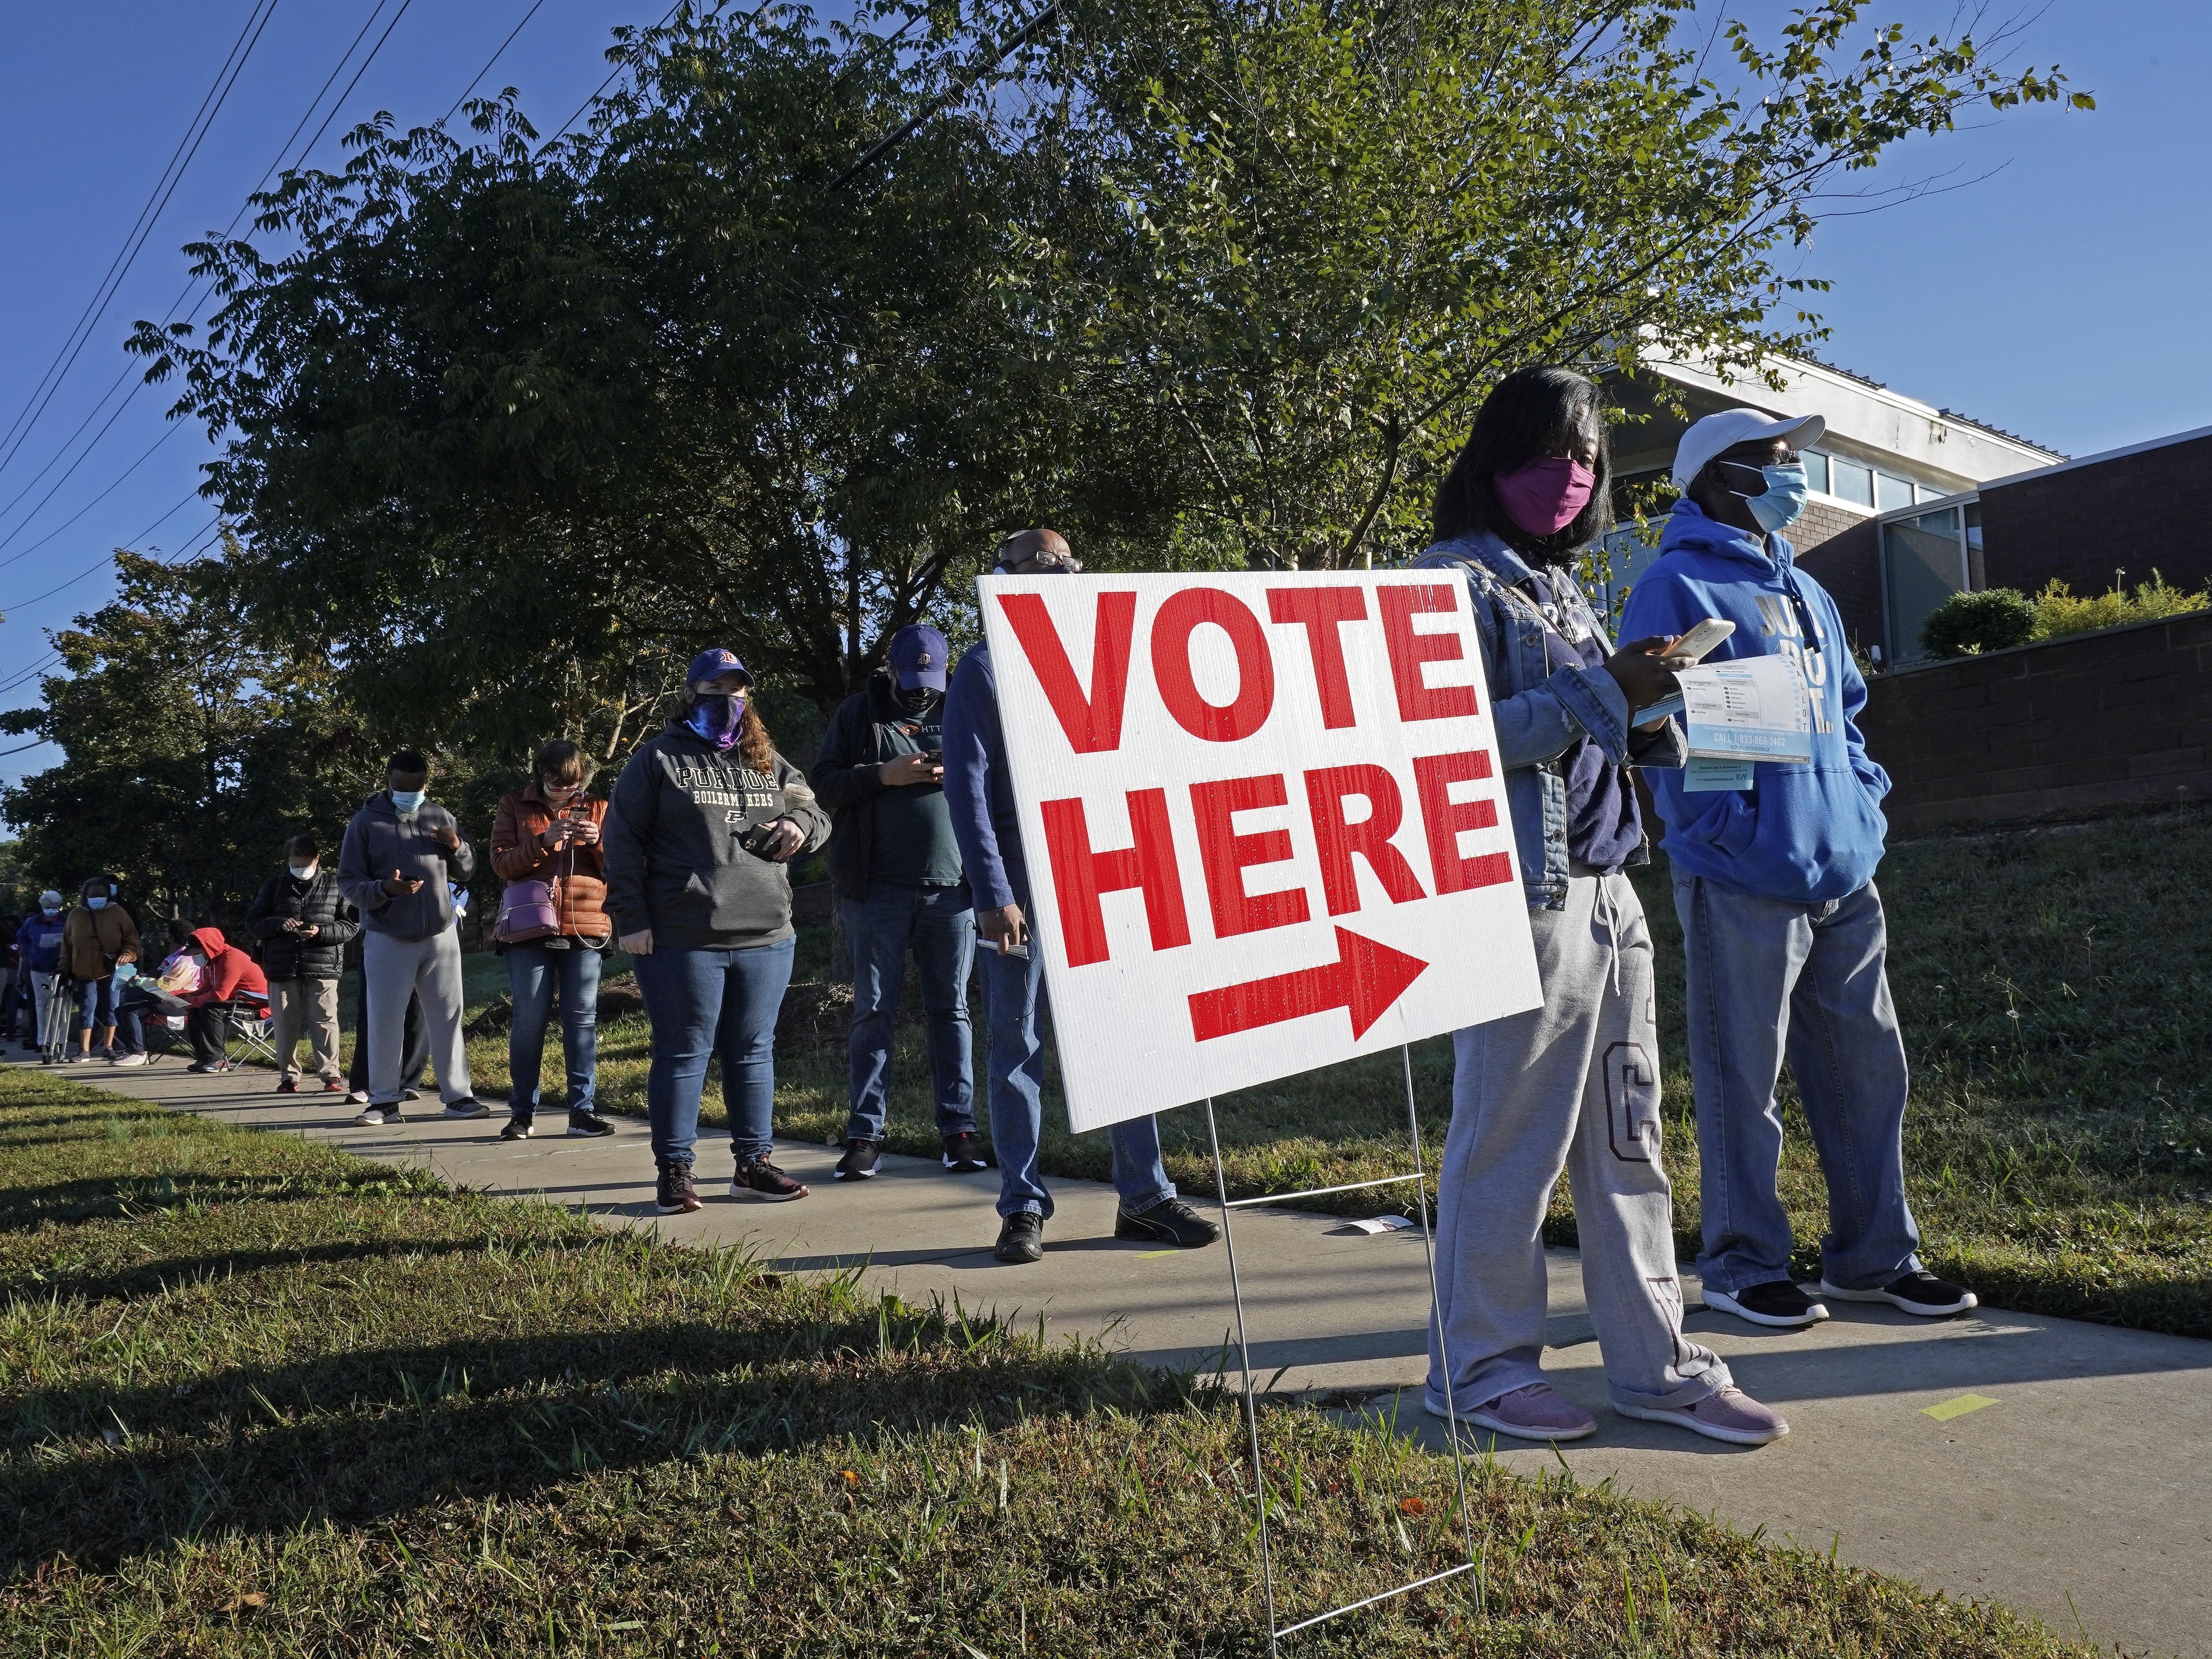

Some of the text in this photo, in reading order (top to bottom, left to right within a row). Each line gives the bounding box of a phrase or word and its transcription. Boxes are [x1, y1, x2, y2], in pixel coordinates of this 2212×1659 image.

[1754, 595, 1825, 639] JUT
[996, 583, 1479, 754] VOTE
[1789, 661, 1807, 731] BALLOT
[1808, 688, 1834, 734] T.
[921, 725, 943, 733] HTT
[1714, 733, 1785, 747] CALL 1-833-868-3462
[676, 766, 780, 790] PURDUE
[693, 790, 773, 807] BOILERMAKERS
[1040, 749, 1514, 968] HERE
